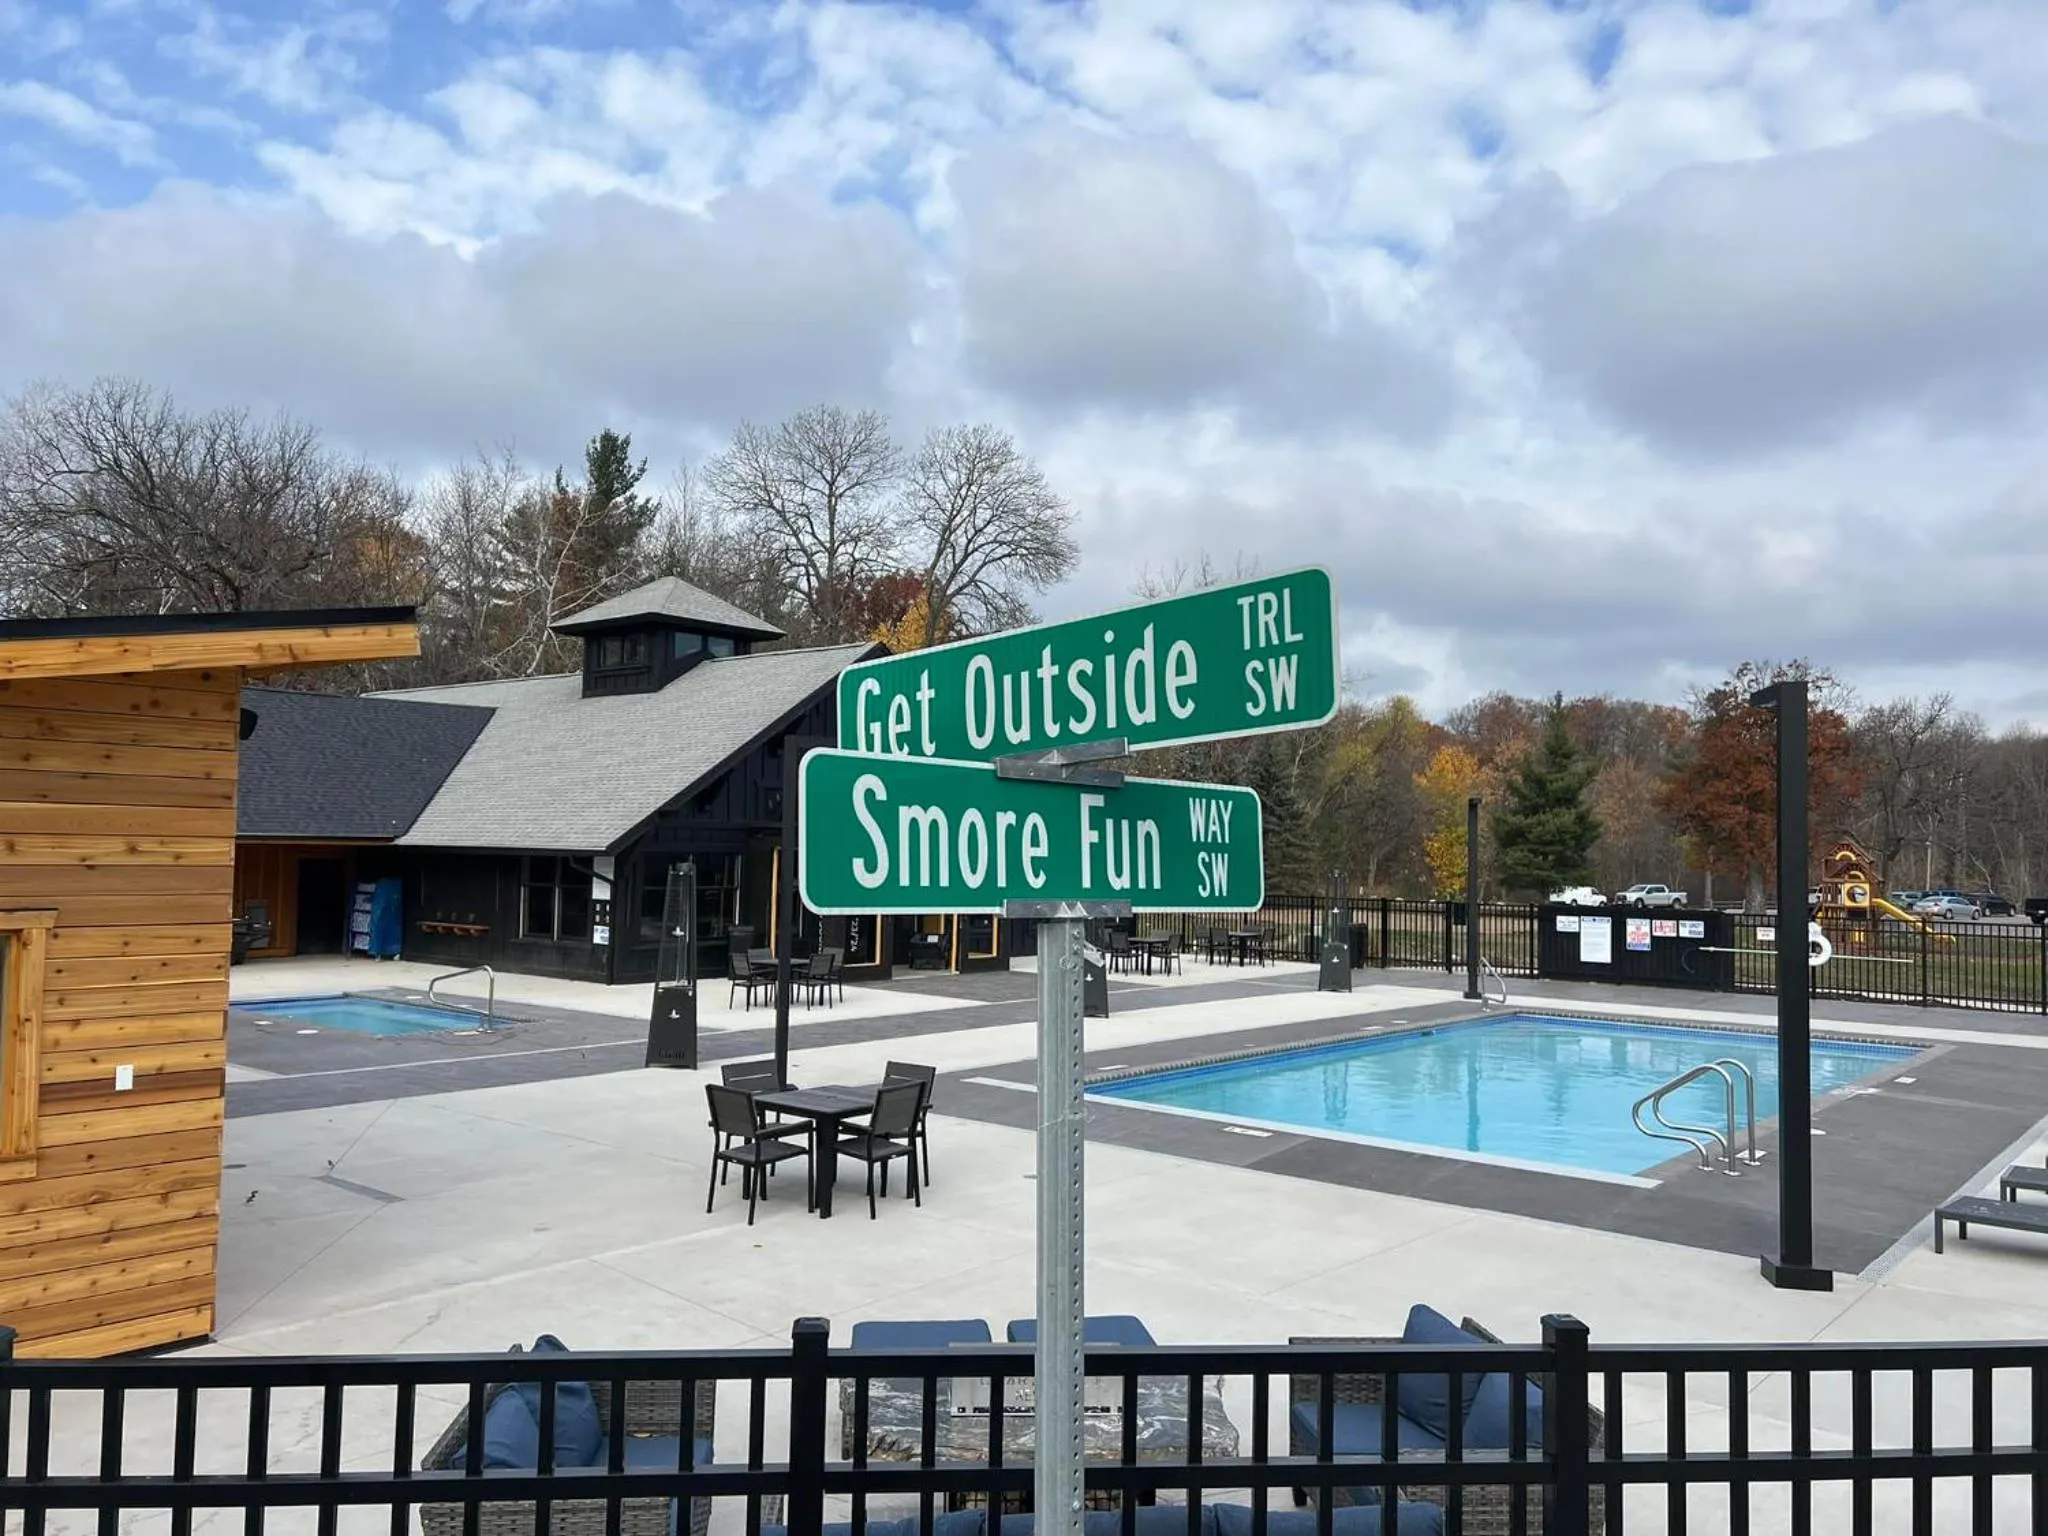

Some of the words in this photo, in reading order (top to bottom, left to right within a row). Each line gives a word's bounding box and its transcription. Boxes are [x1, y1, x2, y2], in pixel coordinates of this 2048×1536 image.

[1237, 588, 1304, 650] TRL
[855, 669, 936, 757] Get
[965, 623, 1197, 750] Outside
[1245, 654, 1298, 717] SW
[852, 773, 1049, 889] Smore
[1080, 794, 1161, 890] Fun
[1189, 798, 1233, 844] WAY
[1198, 851, 1229, 898] SW
